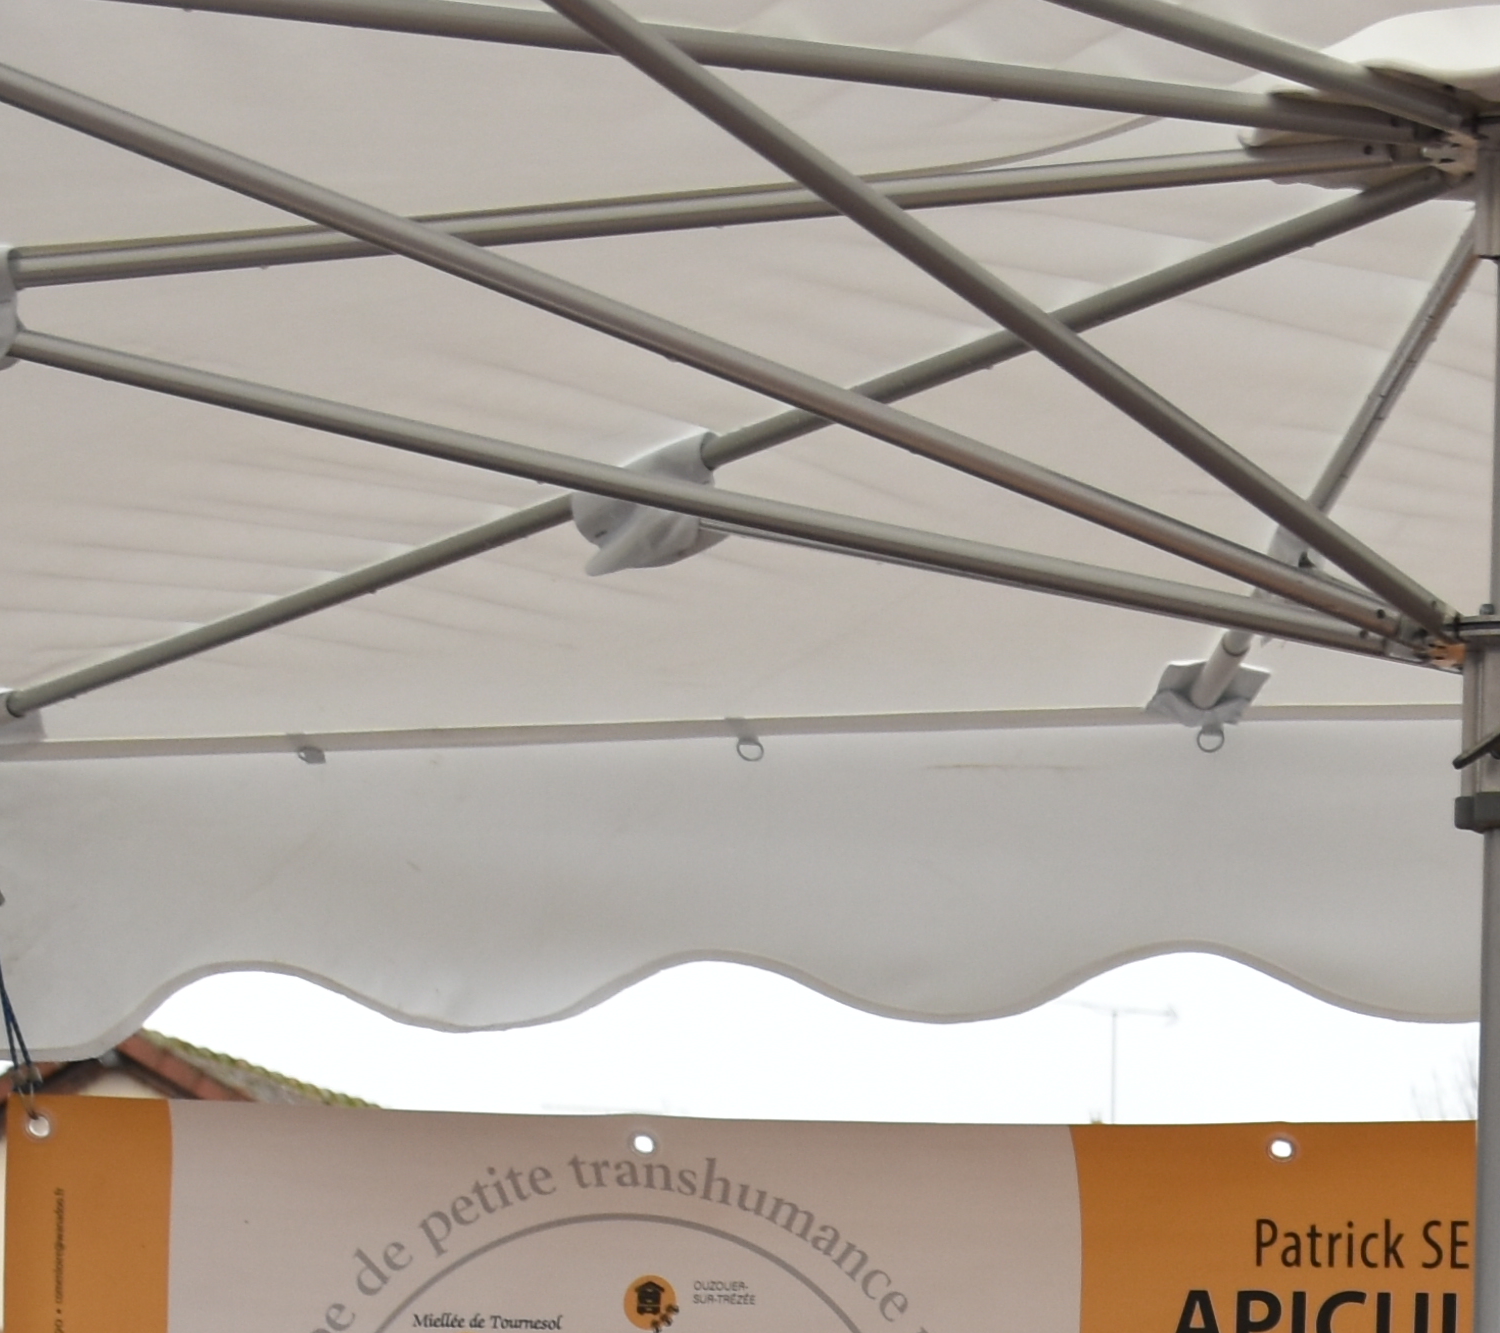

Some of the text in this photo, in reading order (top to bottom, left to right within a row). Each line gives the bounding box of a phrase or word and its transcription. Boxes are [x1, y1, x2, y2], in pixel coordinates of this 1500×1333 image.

[354, 1240, 413, 1296] de
[418, 1164, 558, 1258] petite
[568, 1155, 908, 1321] transhumance
[1255, 1218, 1404, 1269] Patrick
[413, 1314, 562, 1331] Miellée de Tournesol
